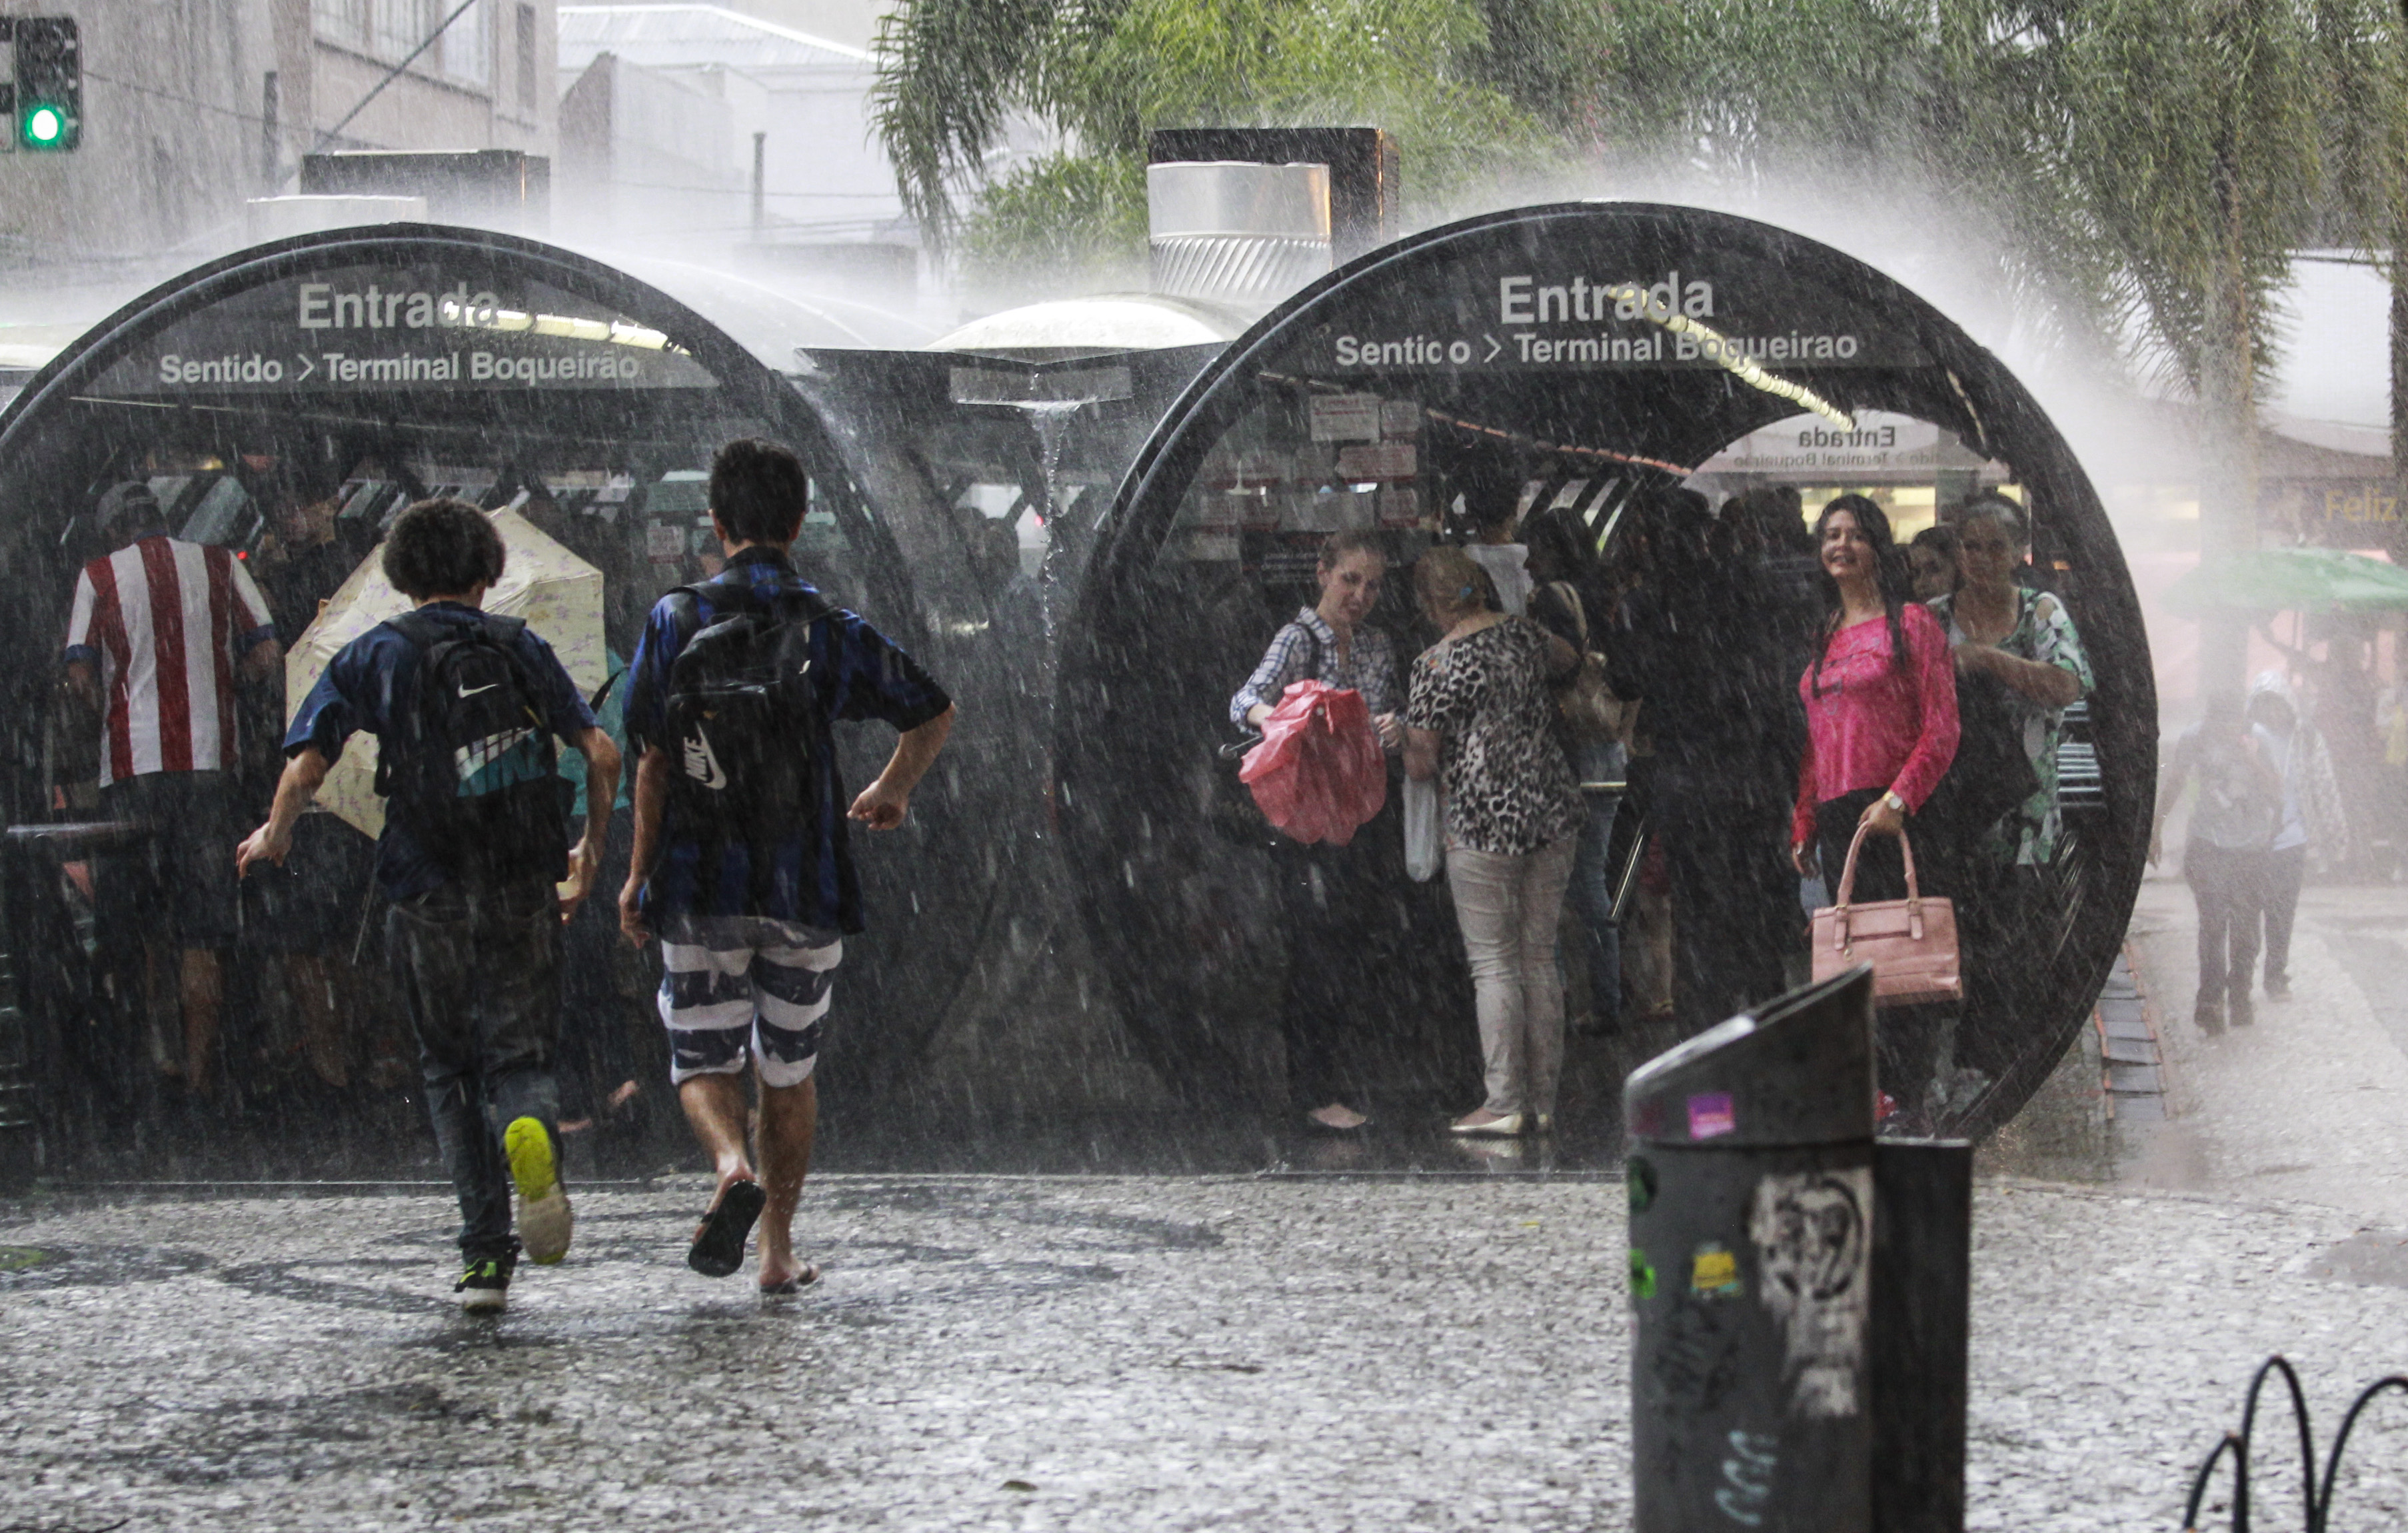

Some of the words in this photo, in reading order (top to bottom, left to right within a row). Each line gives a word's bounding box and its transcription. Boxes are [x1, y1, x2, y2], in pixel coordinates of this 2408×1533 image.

[299, 281, 500, 329] Entrada
[1501, 271, 1714, 324] Entrada
[1514, 332, 1662, 363] Terminal
[159, 353, 283, 384] Sentido
[323, 352, 459, 382] Terminal
[471, 351, 639, 387] Boqueirão
[2325, 488, 2397, 522] Feliz
